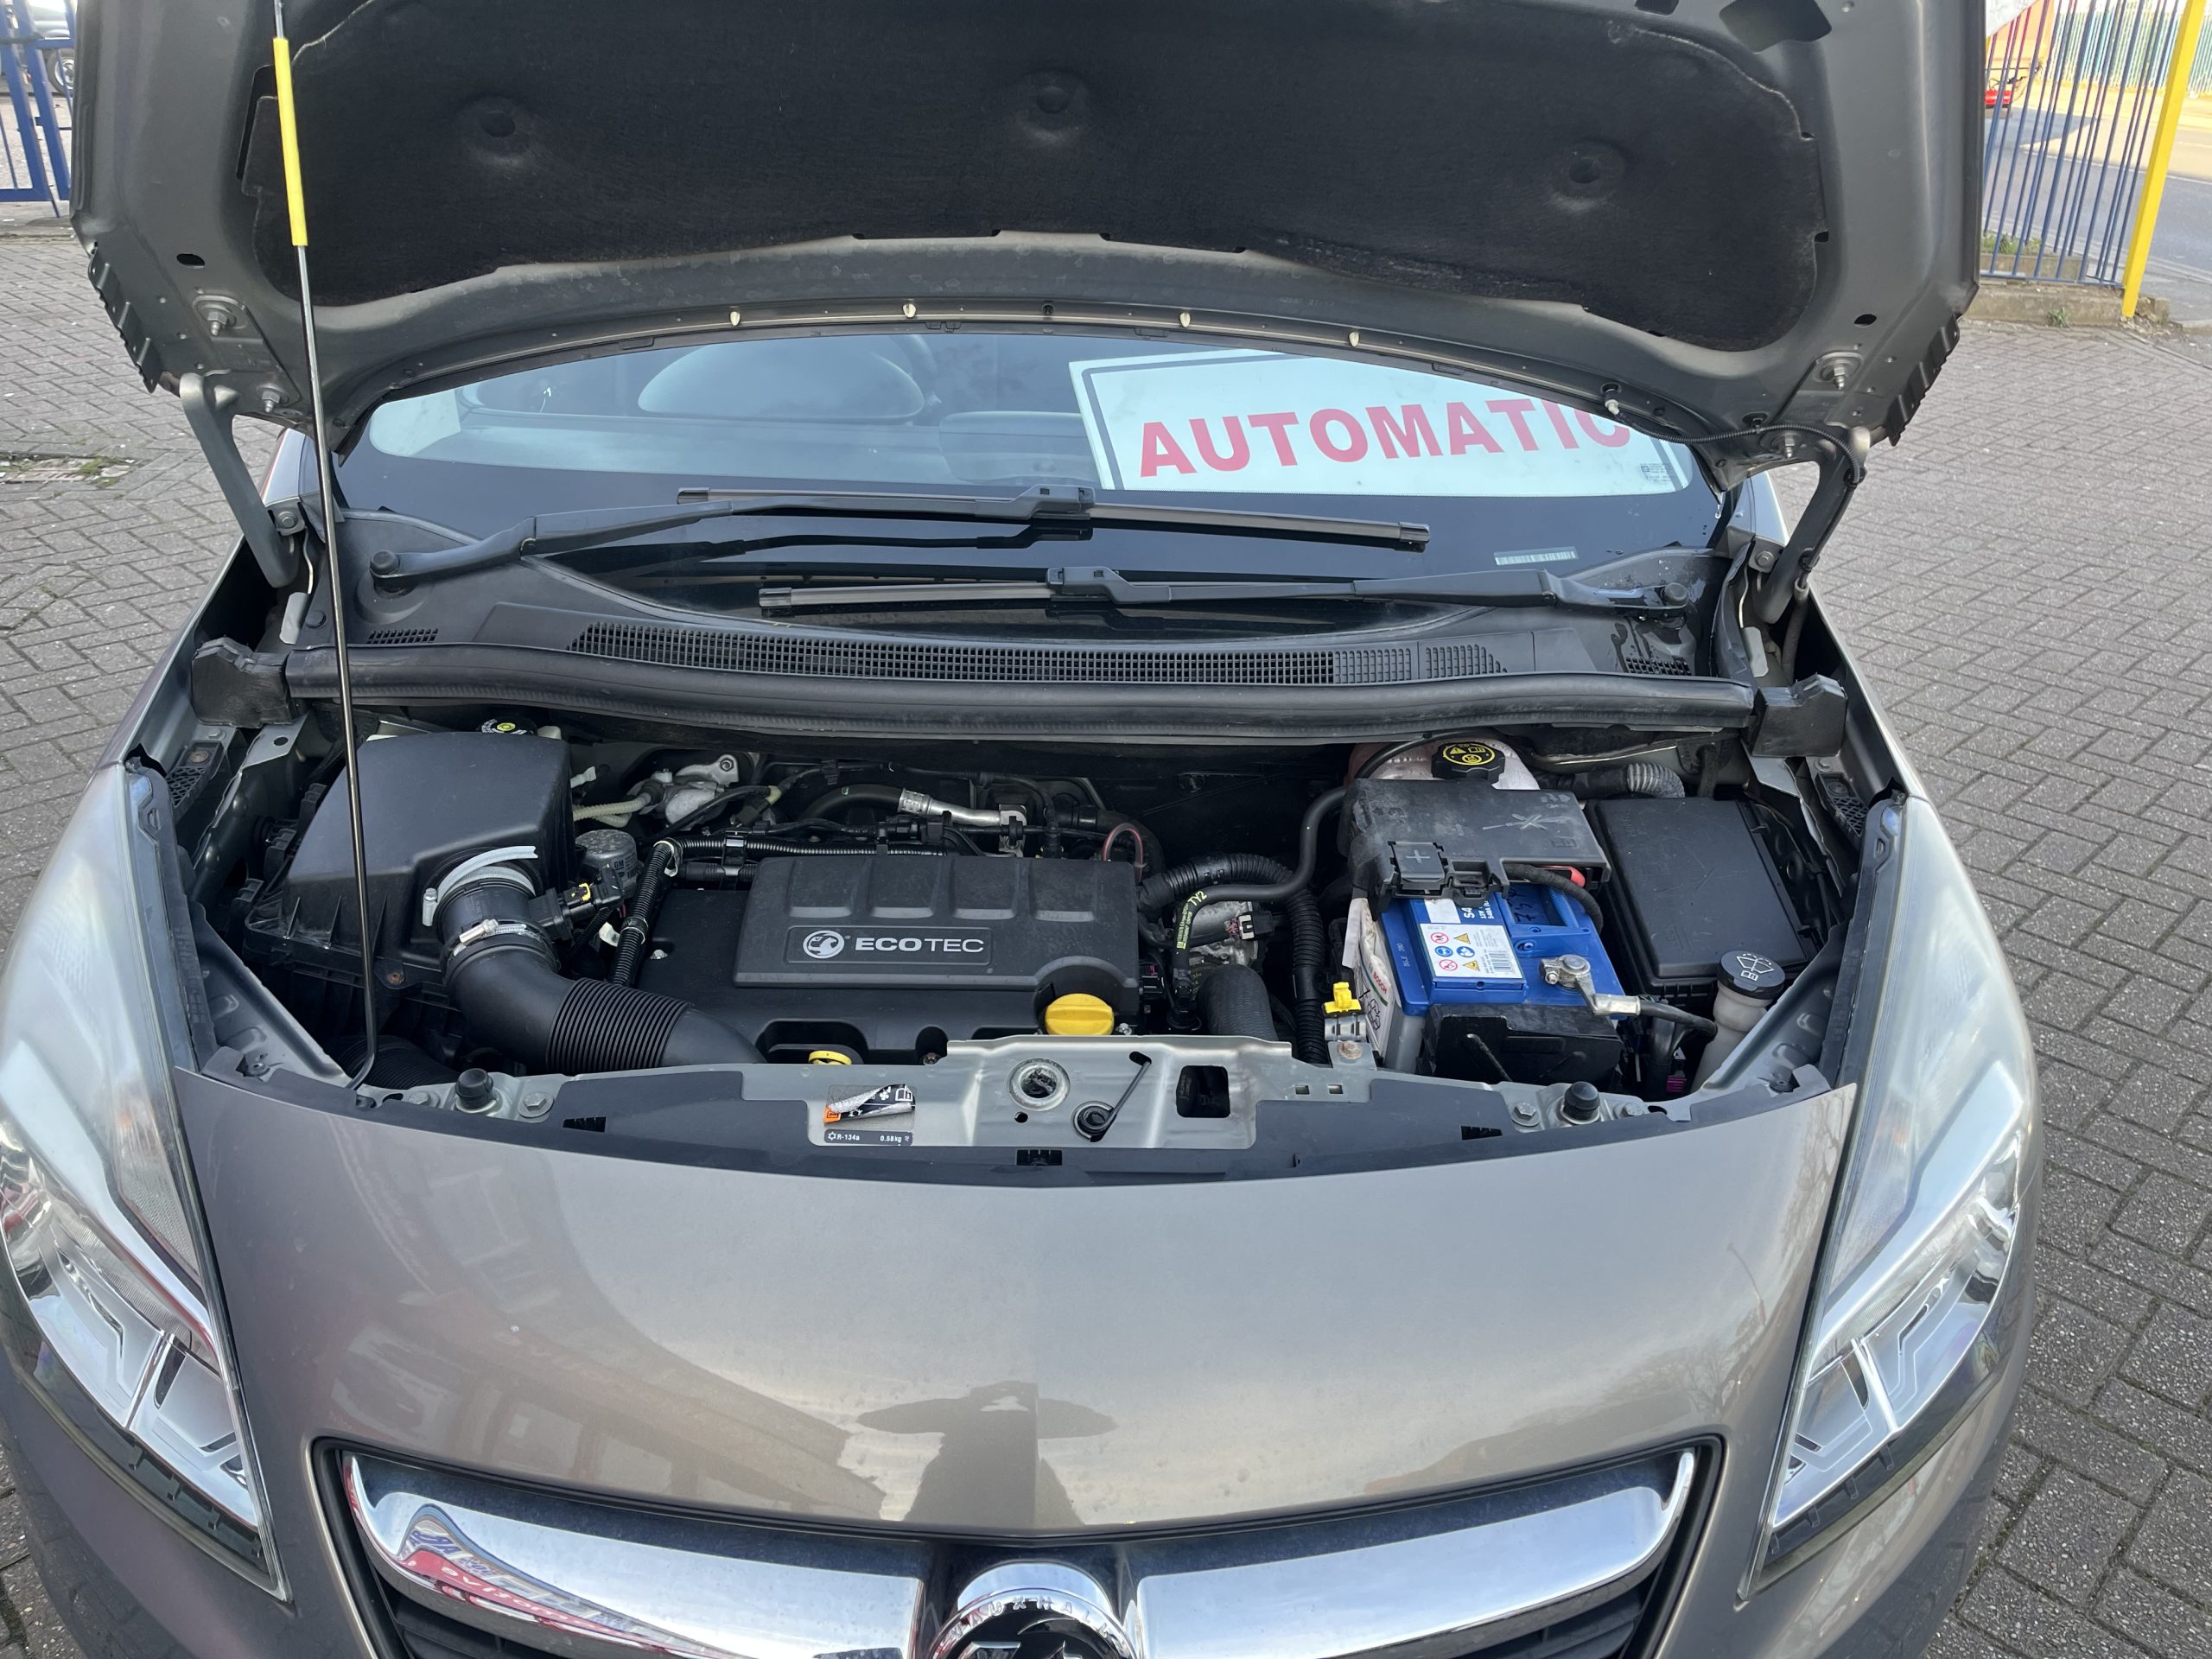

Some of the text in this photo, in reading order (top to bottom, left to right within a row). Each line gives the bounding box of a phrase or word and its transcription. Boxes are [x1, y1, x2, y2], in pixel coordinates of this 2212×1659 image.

[1141, 398, 1630, 477] AUTOMATIC
[1187, 891, 1207, 906] TY2
[855, 938, 984, 952] ECOTEC
[950, 1597, 1114, 1640] VAUXHALL
